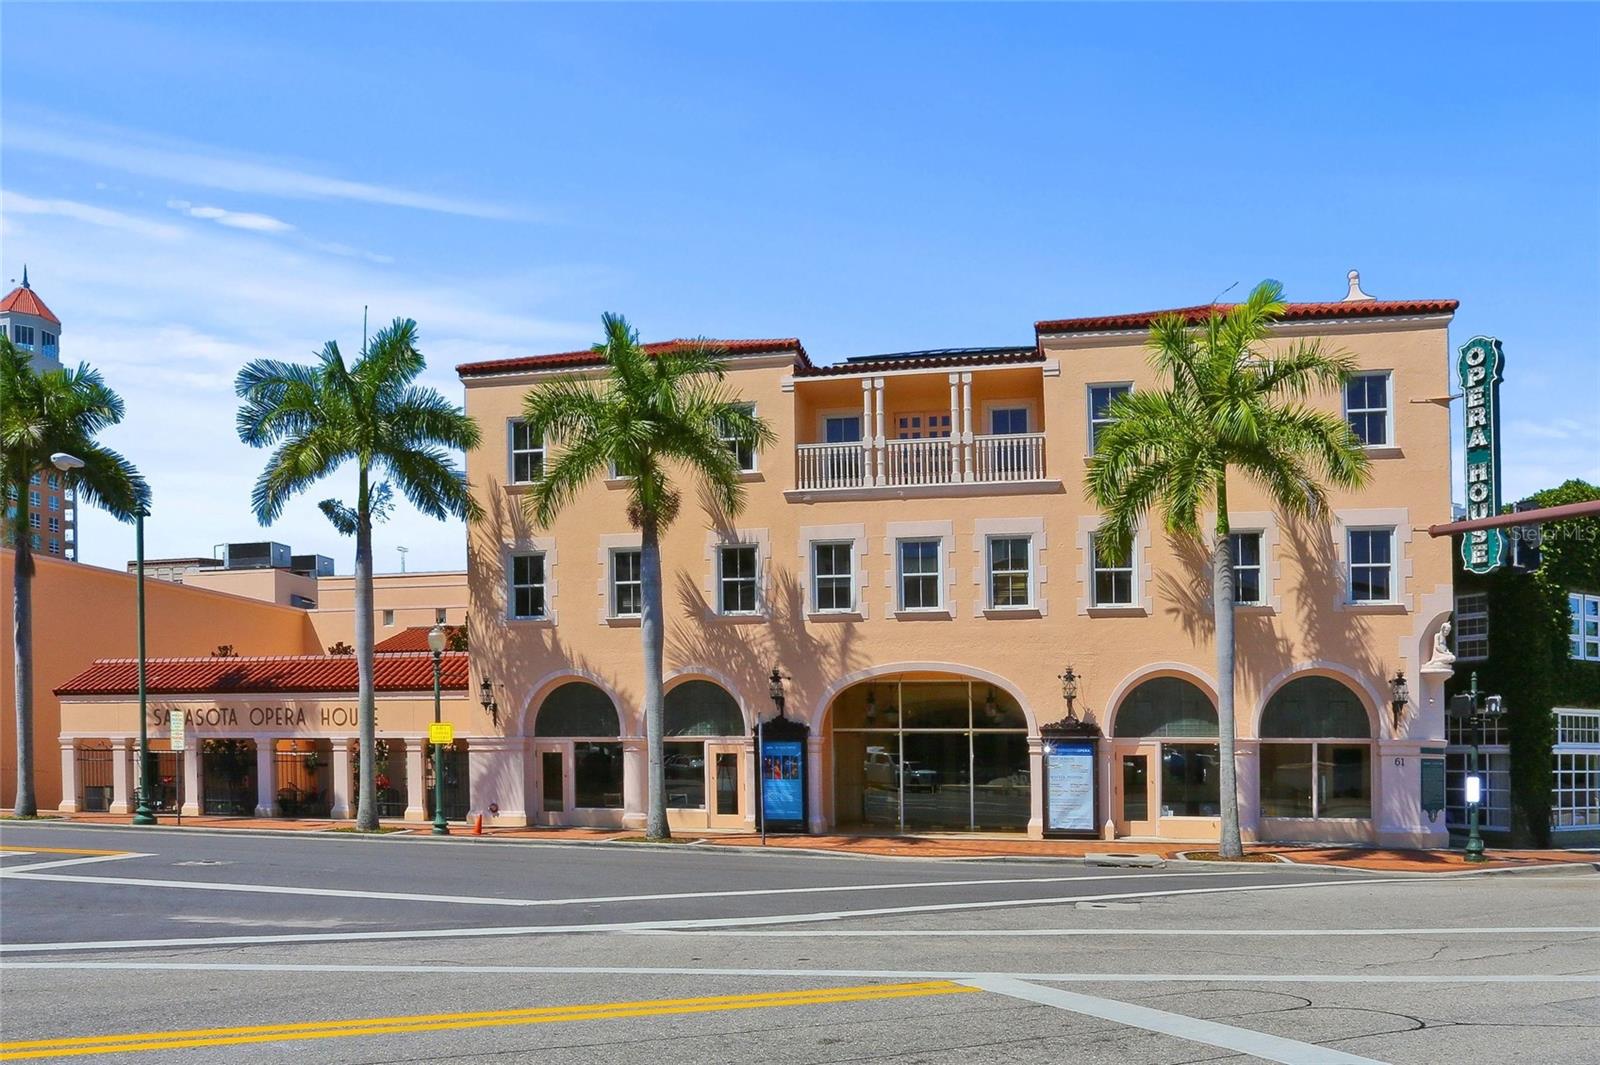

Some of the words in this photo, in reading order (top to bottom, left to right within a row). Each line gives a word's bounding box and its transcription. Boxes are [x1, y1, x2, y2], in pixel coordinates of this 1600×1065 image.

[1466, 347, 1488, 448] OPERA
[153, 708, 238, 726] SAASOTA
[249, 707, 306, 726] OPERA
[321, 708, 379, 726] HOU
[1394, 757, 1405, 767] 61
